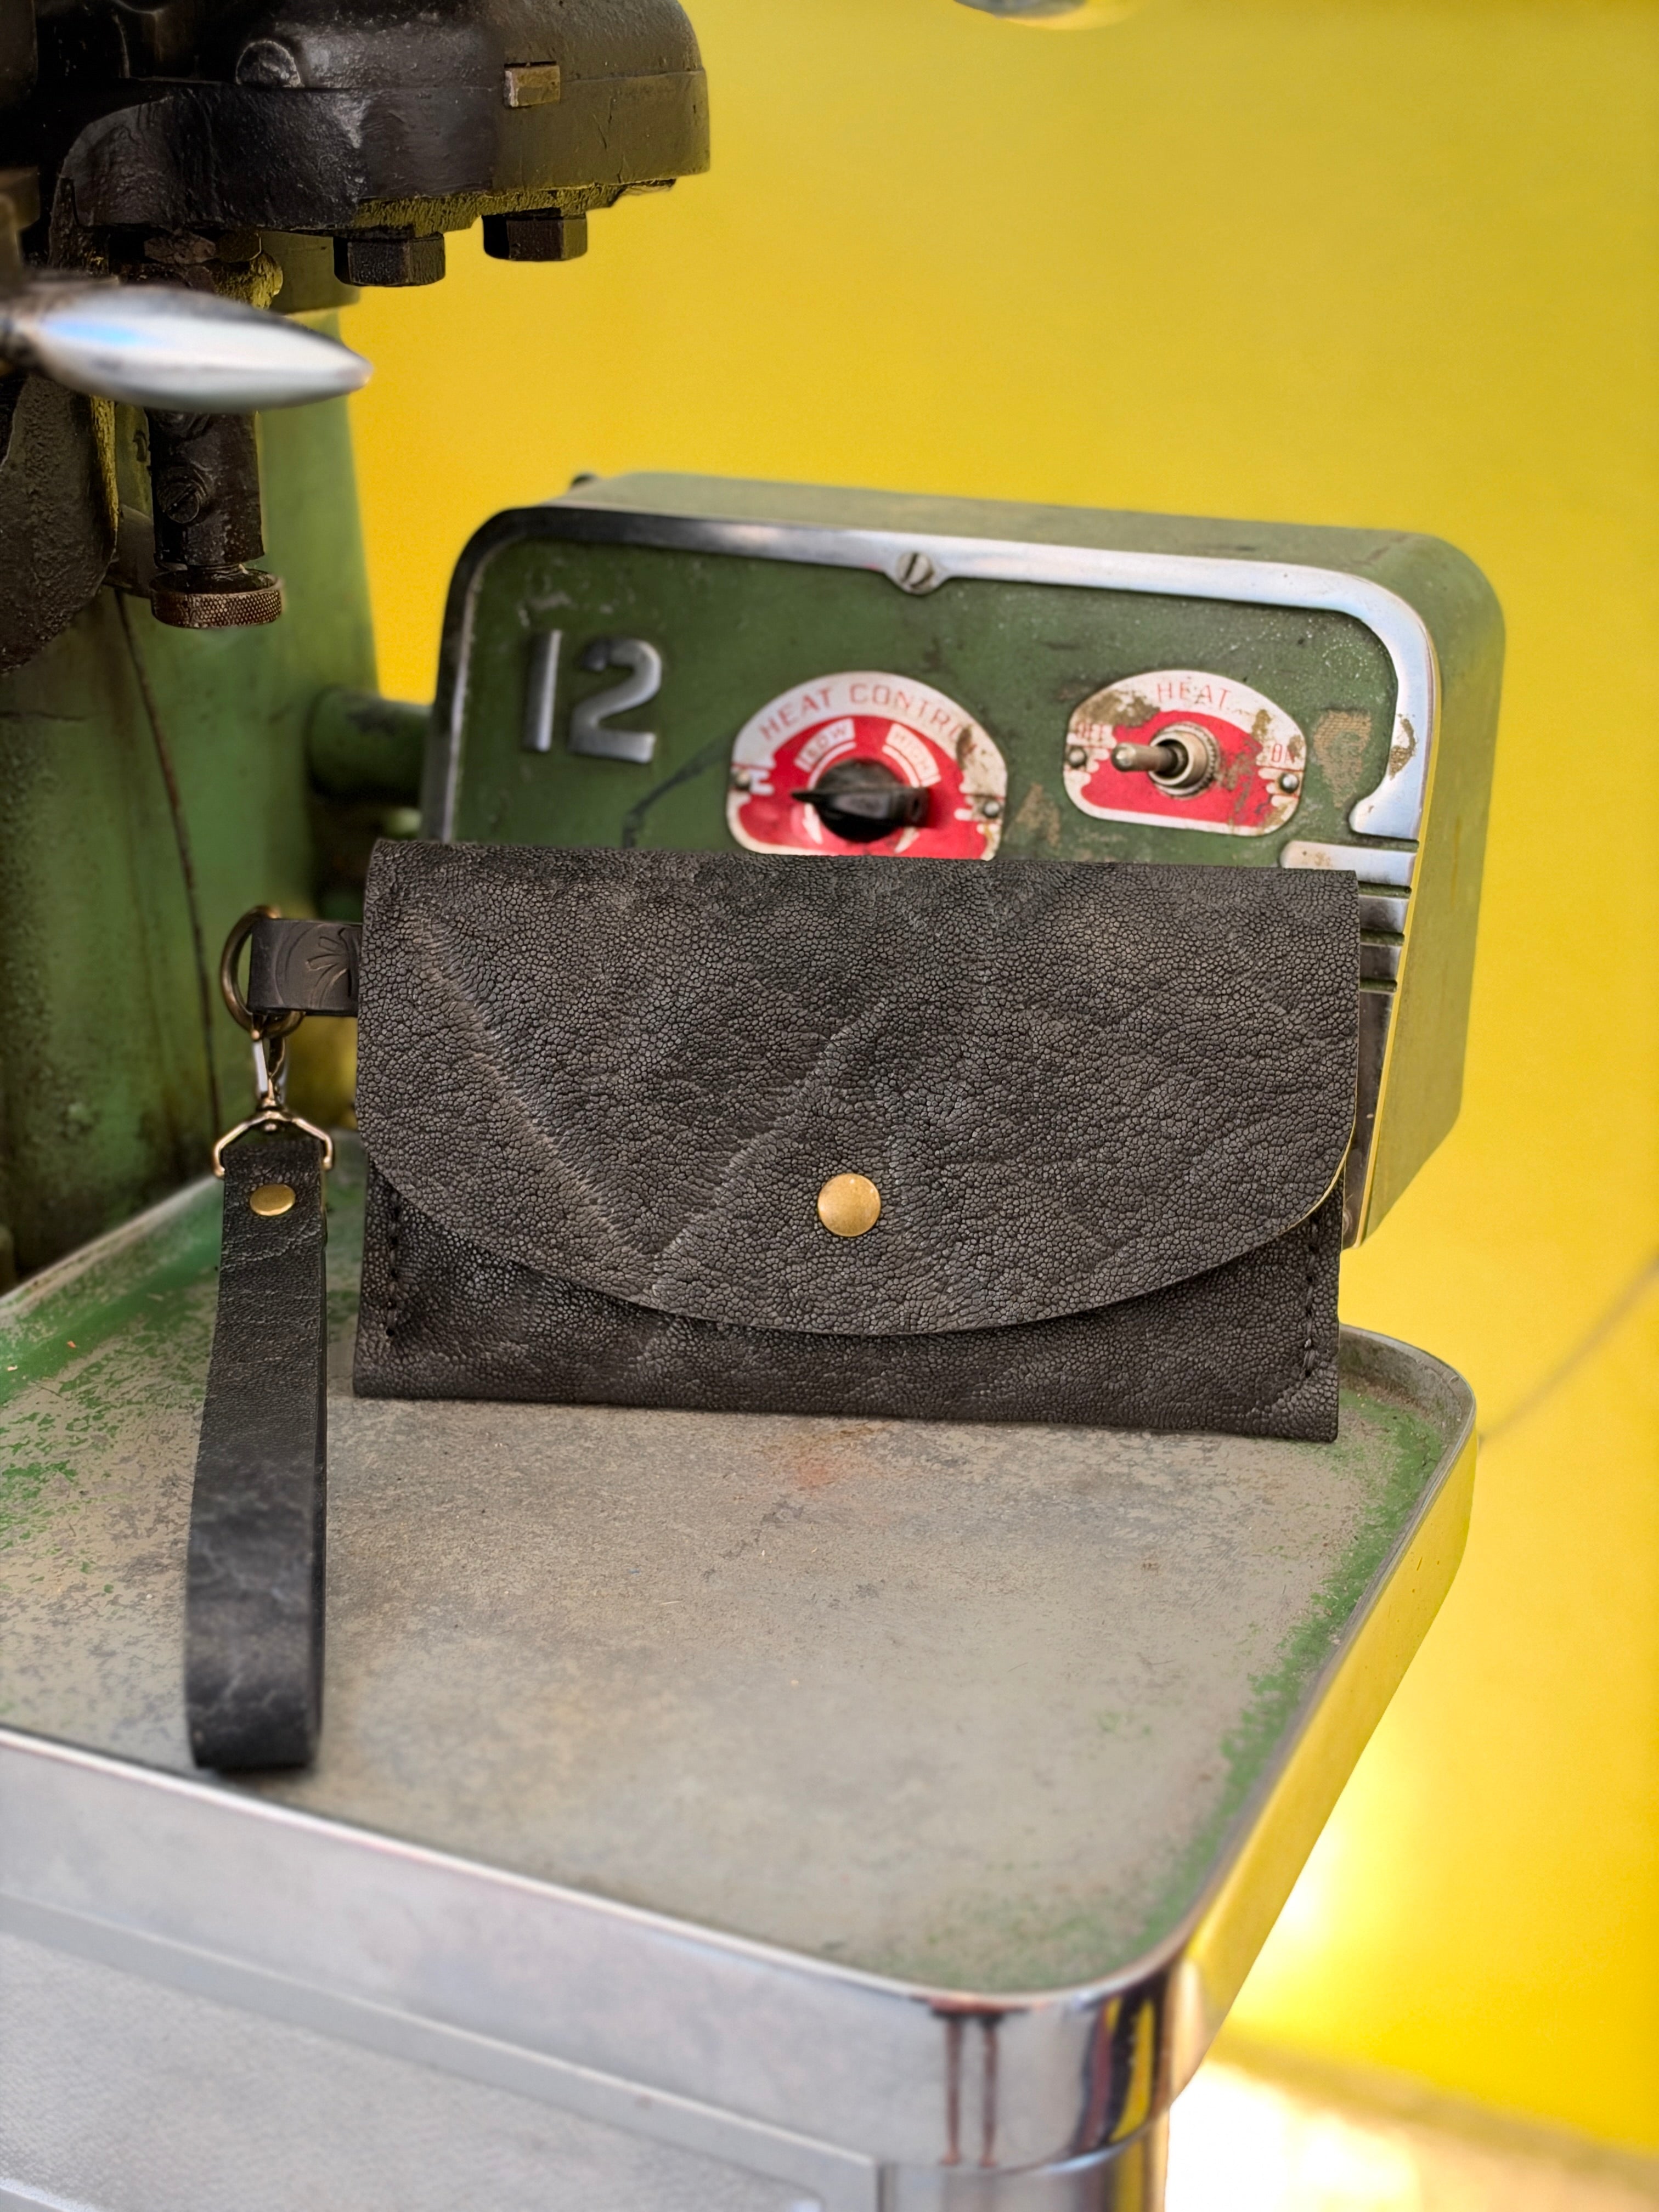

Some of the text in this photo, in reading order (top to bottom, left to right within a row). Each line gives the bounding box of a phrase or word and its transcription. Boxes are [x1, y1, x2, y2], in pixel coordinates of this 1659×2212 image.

[526, 629, 662, 764] 12
[759, 687, 832, 740] HEAT
[1157, 682, 1231, 710] HEAT
